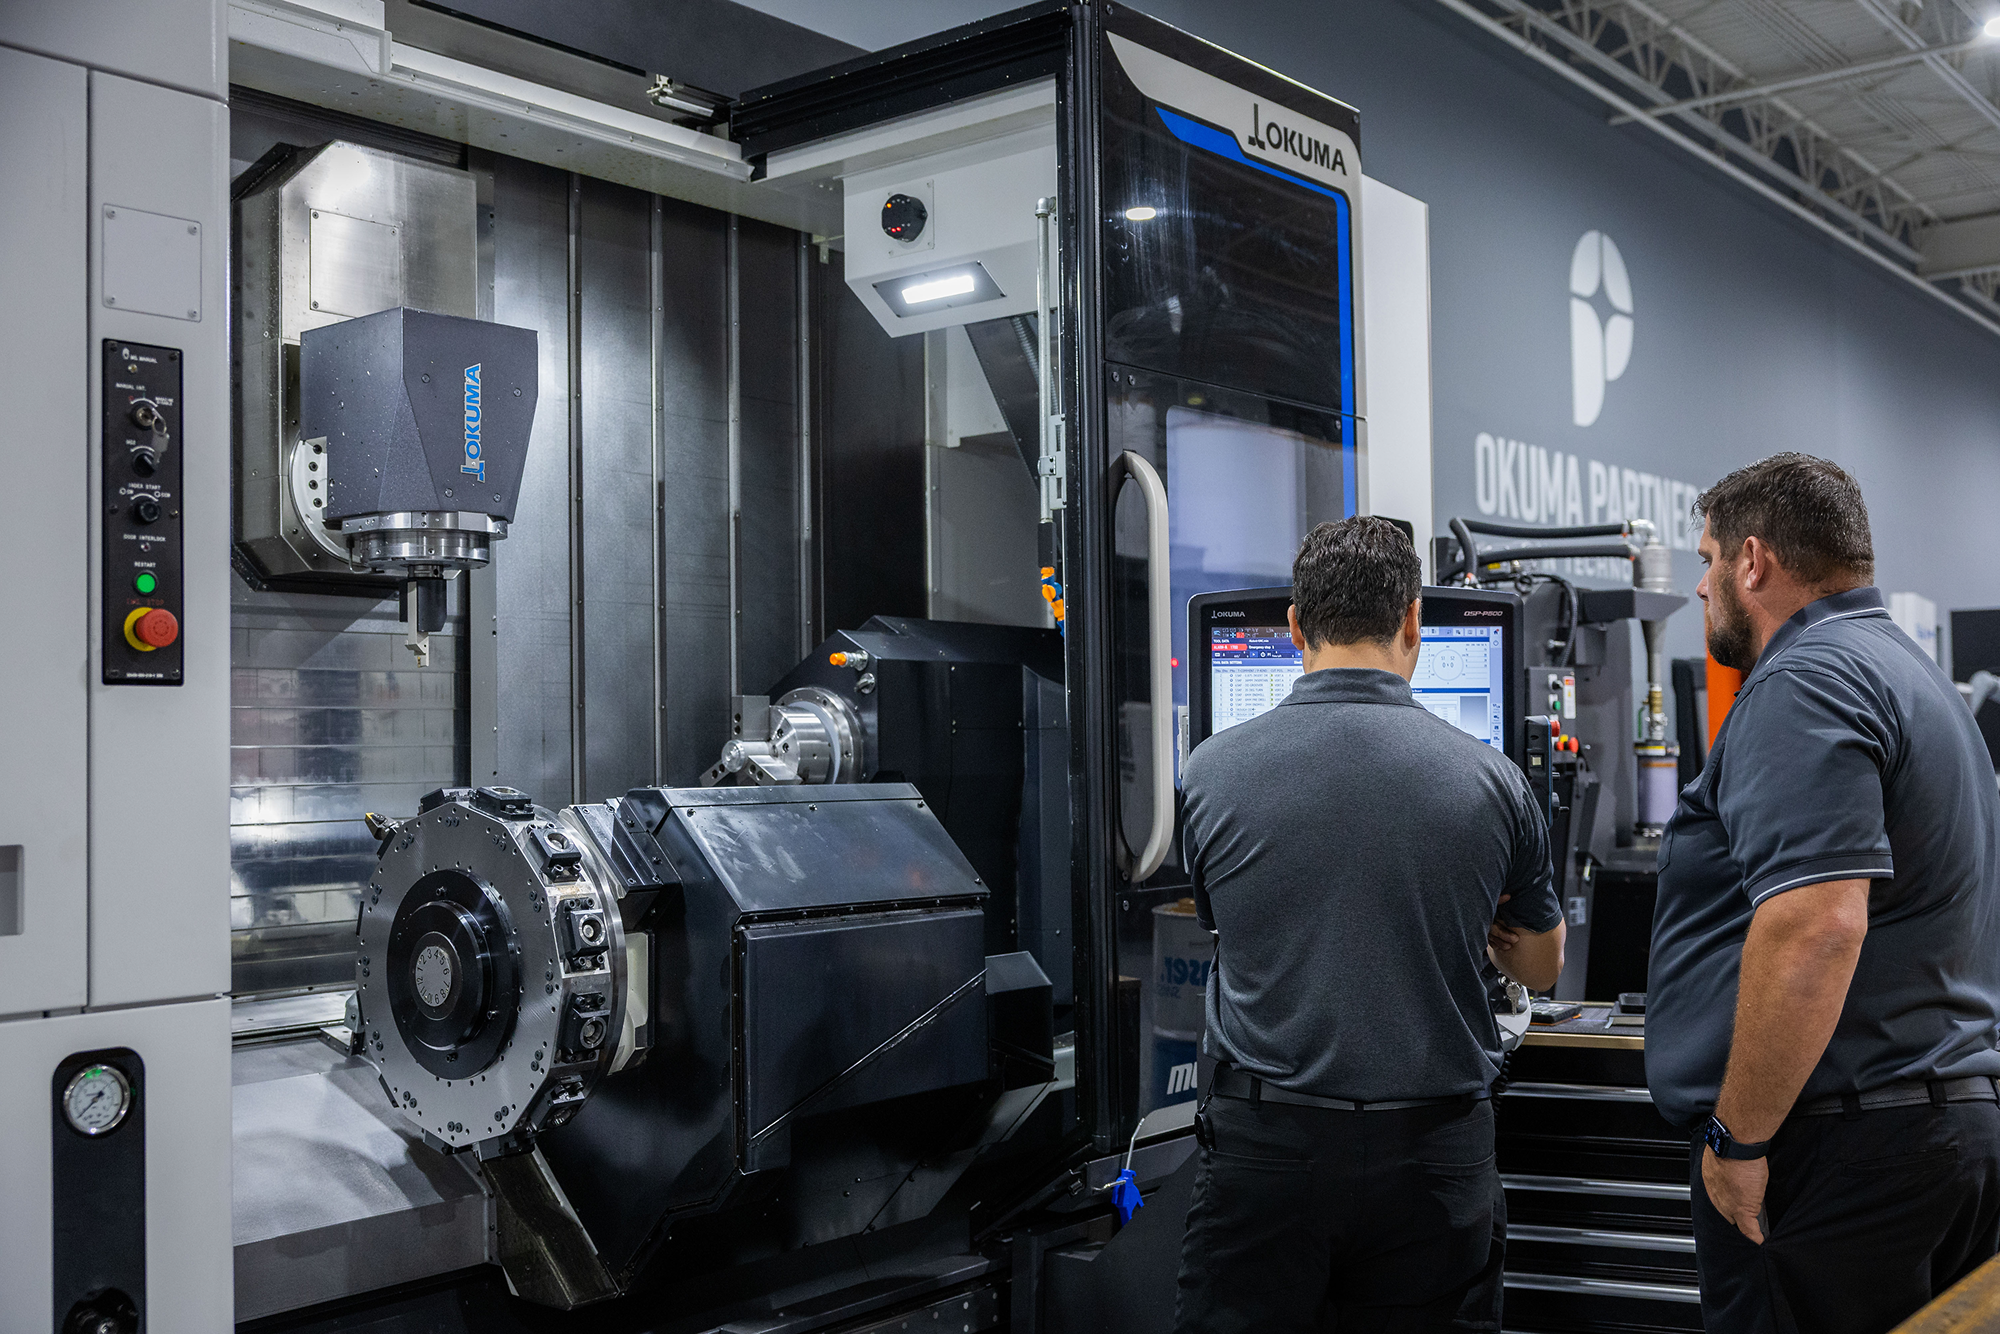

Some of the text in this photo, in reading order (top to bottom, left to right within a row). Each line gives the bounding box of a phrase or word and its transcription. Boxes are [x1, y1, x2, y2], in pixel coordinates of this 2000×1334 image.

[1265, 121, 1348, 177] OKUMA
[464, 362, 482, 461] OKUMA
[1474, 431, 1706, 552] OKUMA PARTNER
[427, 948, 432, 959] 3
[434, 950, 438, 959] 4
[434, 994, 440, 1004] 9
